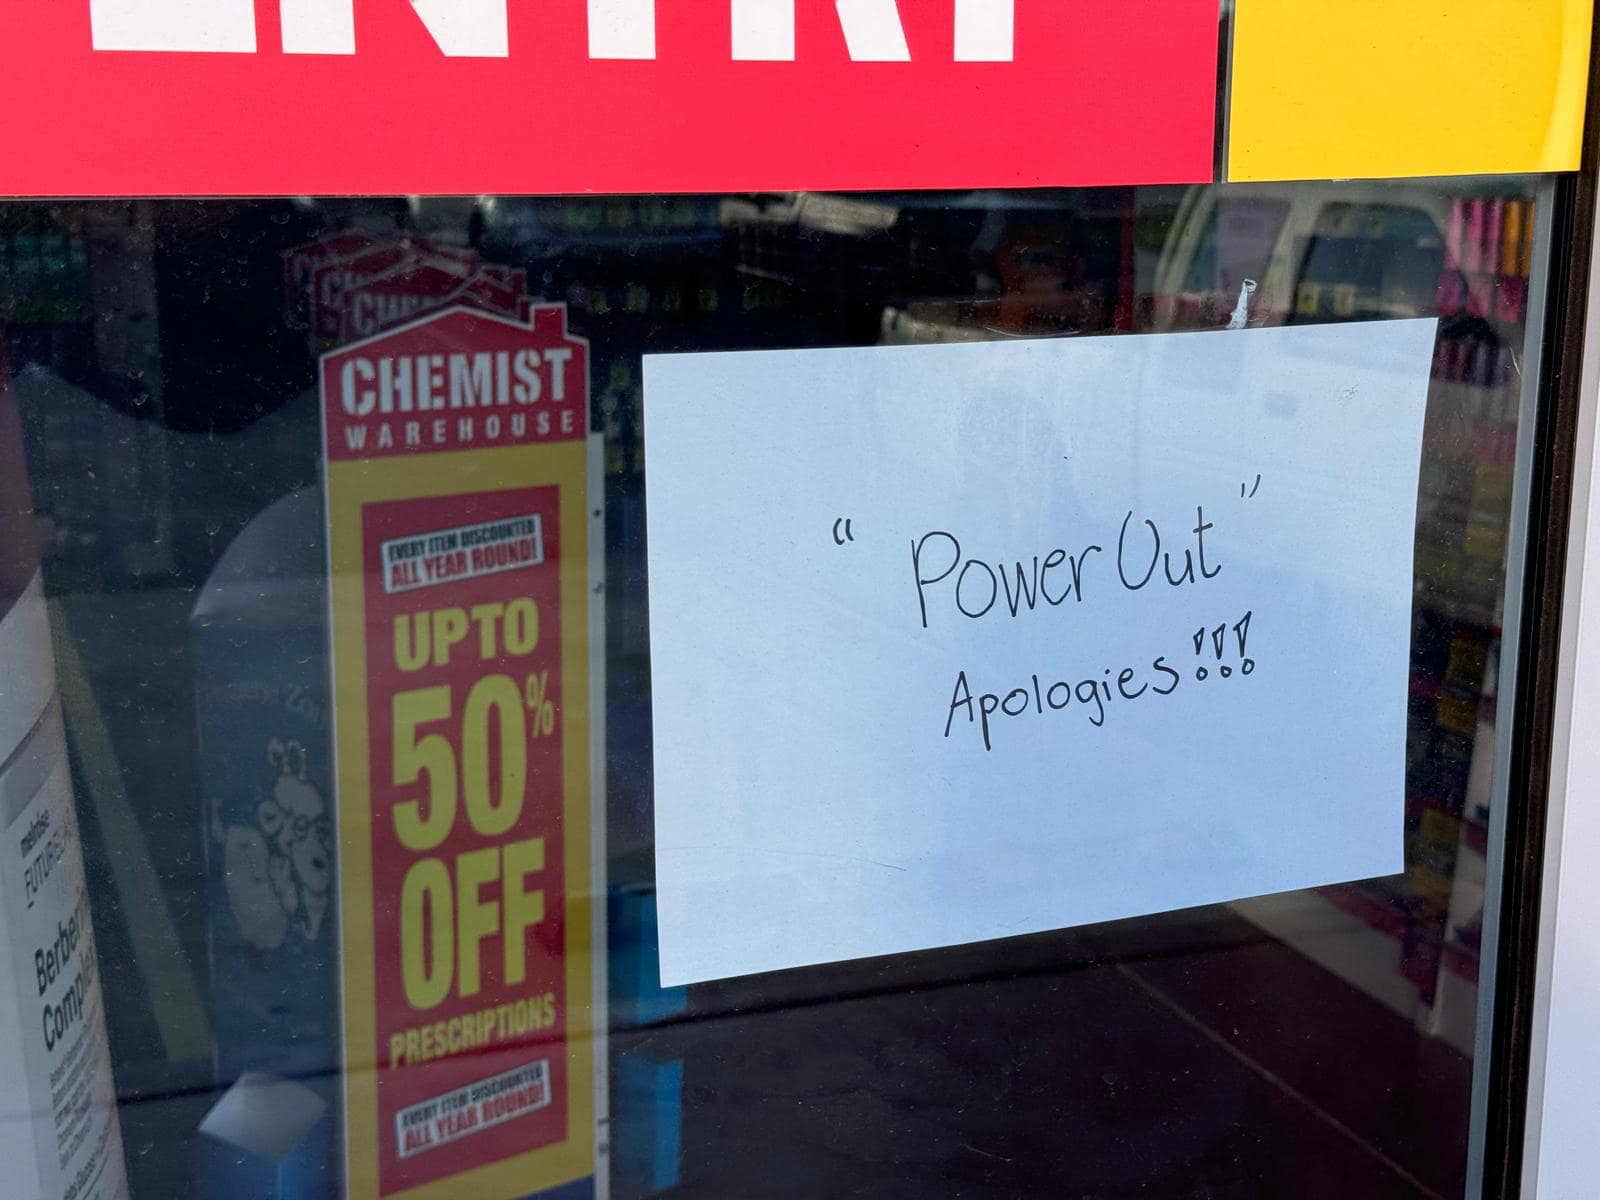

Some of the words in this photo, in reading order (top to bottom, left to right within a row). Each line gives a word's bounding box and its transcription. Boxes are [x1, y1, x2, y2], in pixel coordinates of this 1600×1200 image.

[340, 347, 572, 417] CHEMIST
[345, 410, 574, 450] WAREHOUSE
[388, 538, 426, 562] EVERY
[429, 533, 458, 555] ITEM
[460, 518, 536, 548] DISCOUNTED
[391, 559, 420, 587] ALL
[422, 548, 468, 581] YEAR
[471, 537, 538, 573] ROUND!
[911, 531, 1102, 628] Power
[1117, 505, 1222, 590] Out
[402, 837, 545, 1010] OFF
[390, 993, 556, 1070] PRESCRIPTIONS
[404, 1120, 433, 1151] ALL
[435, 1104, 478, 1140] YEAR
